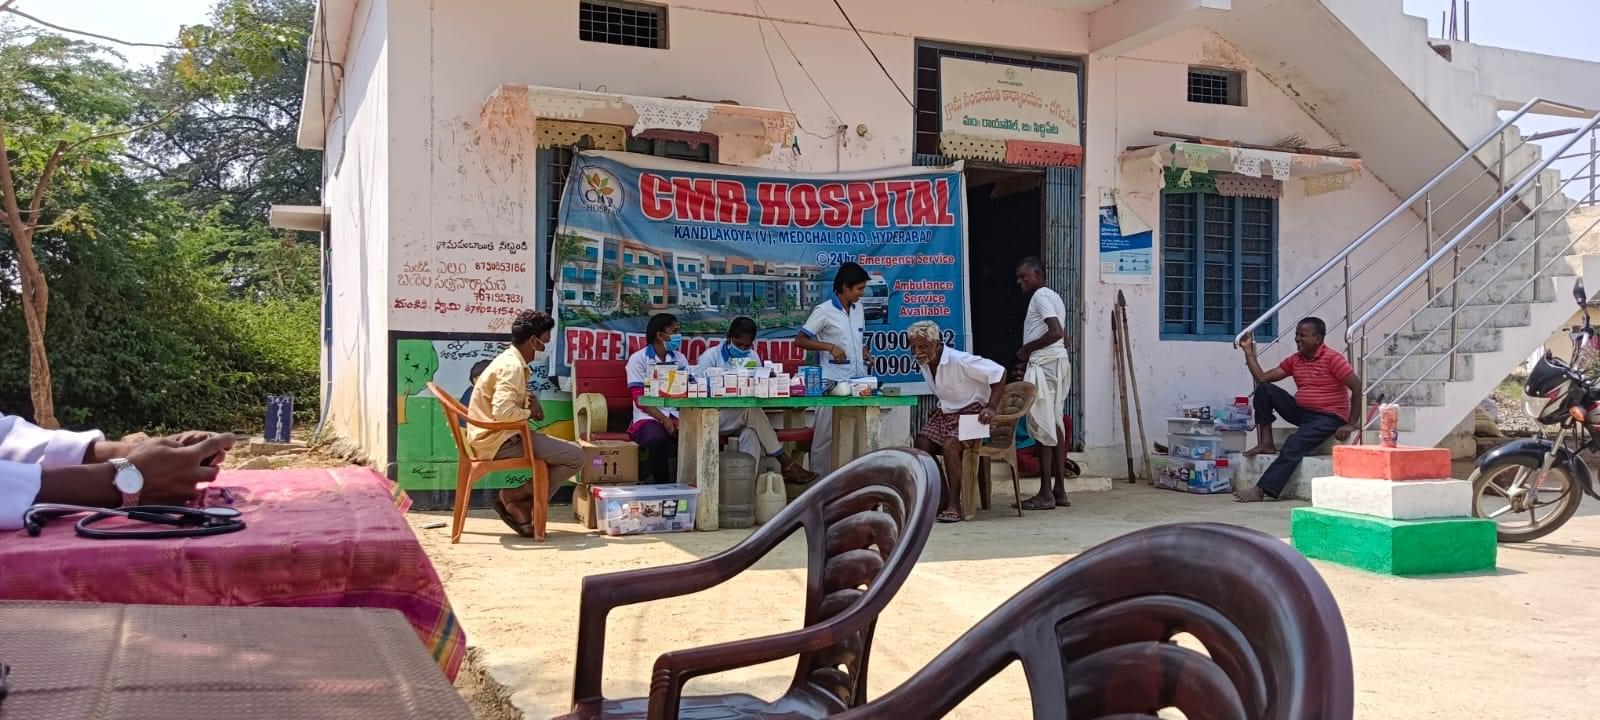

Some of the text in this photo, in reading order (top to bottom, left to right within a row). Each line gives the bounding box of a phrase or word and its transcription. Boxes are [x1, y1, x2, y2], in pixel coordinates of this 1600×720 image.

[638, 172, 955, 228] CMR HOSPITAL
[674, 224, 753, 242] KANDLAKOYA
[778, 230, 834, 244] MEDCHAL
[871, 230, 932, 245] HYDERABAD
[858, 254, 916, 267] Emergency
[917, 252, 955, 265] Service
[894, 280, 953, 291] Ambulance
[903, 293, 945, 304] Service
[899, 306, 951, 317] Available
[564, 327, 625, 367] FREE
